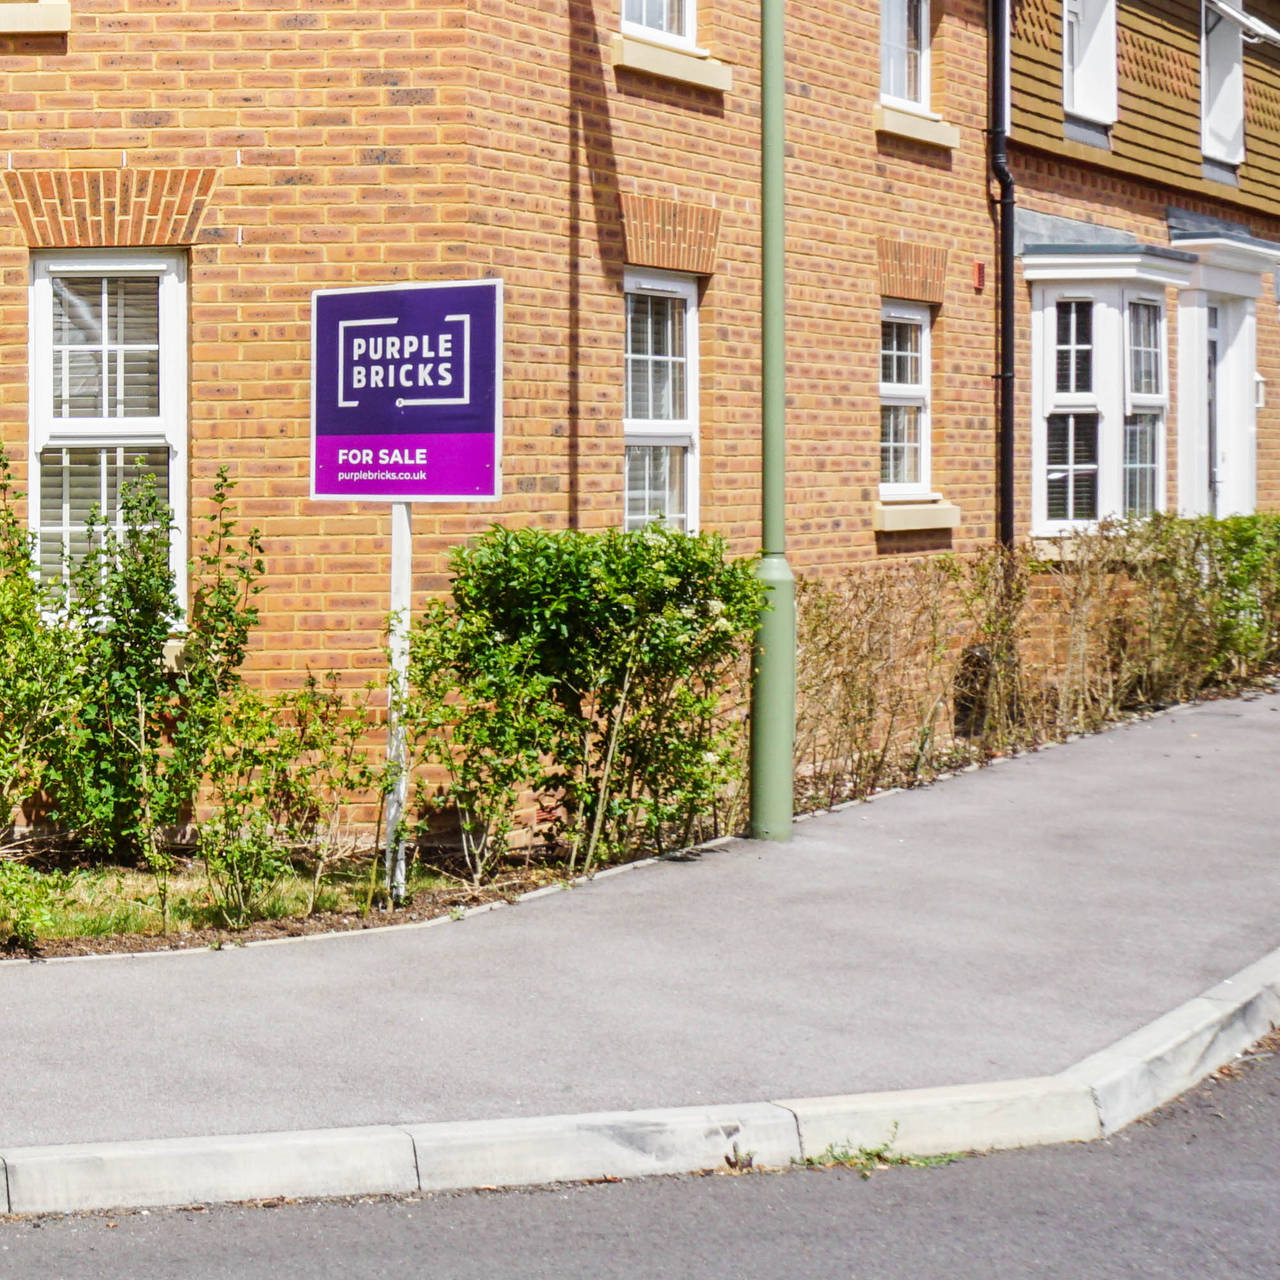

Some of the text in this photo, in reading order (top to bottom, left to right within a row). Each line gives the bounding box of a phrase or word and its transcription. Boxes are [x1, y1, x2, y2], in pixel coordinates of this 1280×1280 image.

[353, 334, 453, 360] PURPLE
[353, 363, 453, 389] BRICKS
[338, 448, 427, 464] FOR SALE
[338, 469, 427, 482] purplebricks.co.uk
